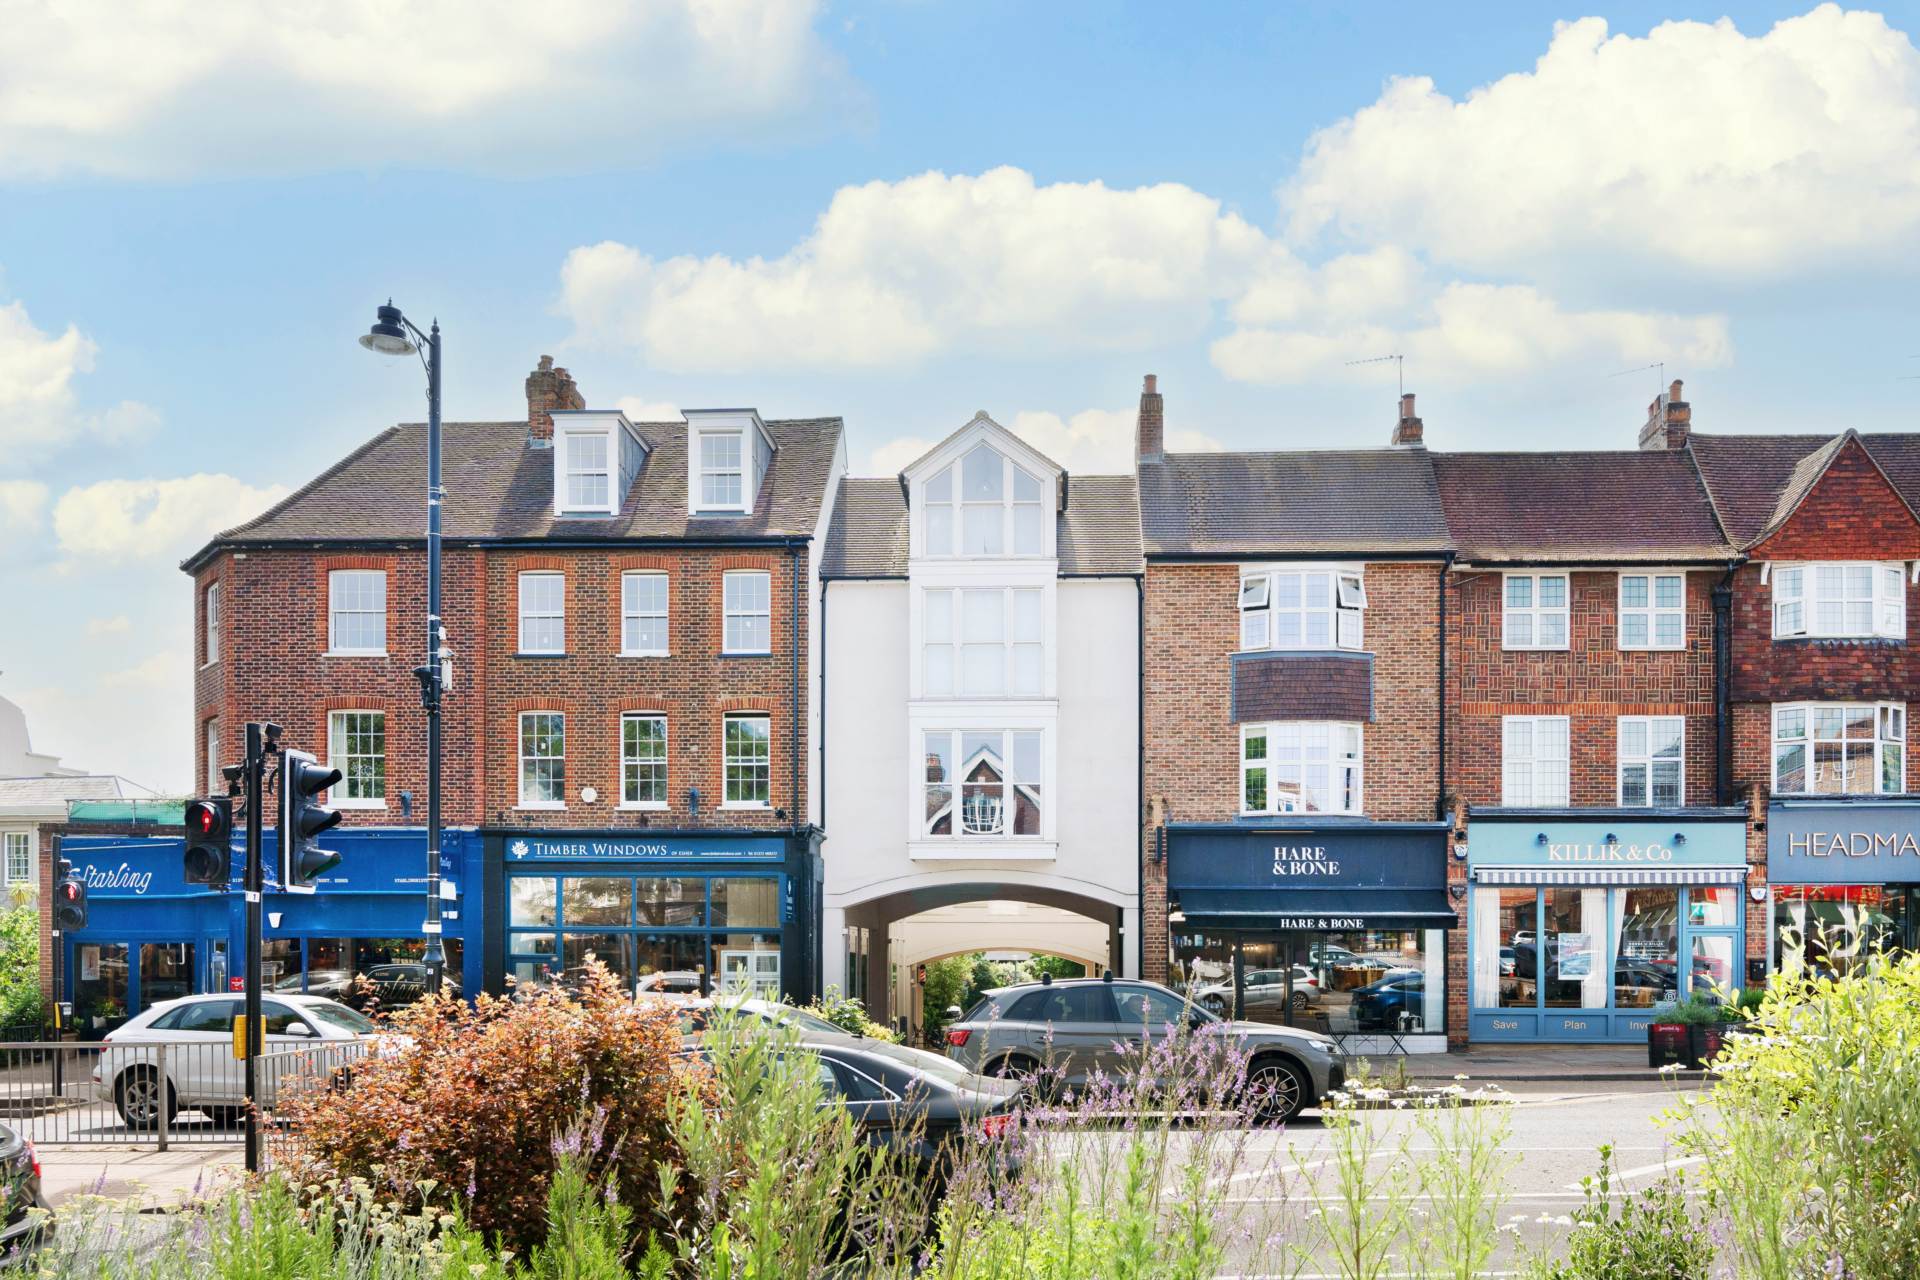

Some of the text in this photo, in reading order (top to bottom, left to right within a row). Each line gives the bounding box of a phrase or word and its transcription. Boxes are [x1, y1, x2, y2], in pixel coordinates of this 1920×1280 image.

[534, 843, 588, 856] TIMBER
[592, 843, 667, 856] WINDOWS
[1789, 832, 1920, 856] HEADMA
[1274, 847, 1326, 861] HARE
[1548, 844, 1623, 861] KILLIK
[1272, 861, 1340, 875] & BONE
[68, 862, 152, 894] Starling
[1280, 919, 1364, 929] HARE & BONE
[1493, 1020, 1517, 1029] Save
[1564, 1020, 1587, 1030] Plan
[1630, 1020, 1648, 1030] Inv
